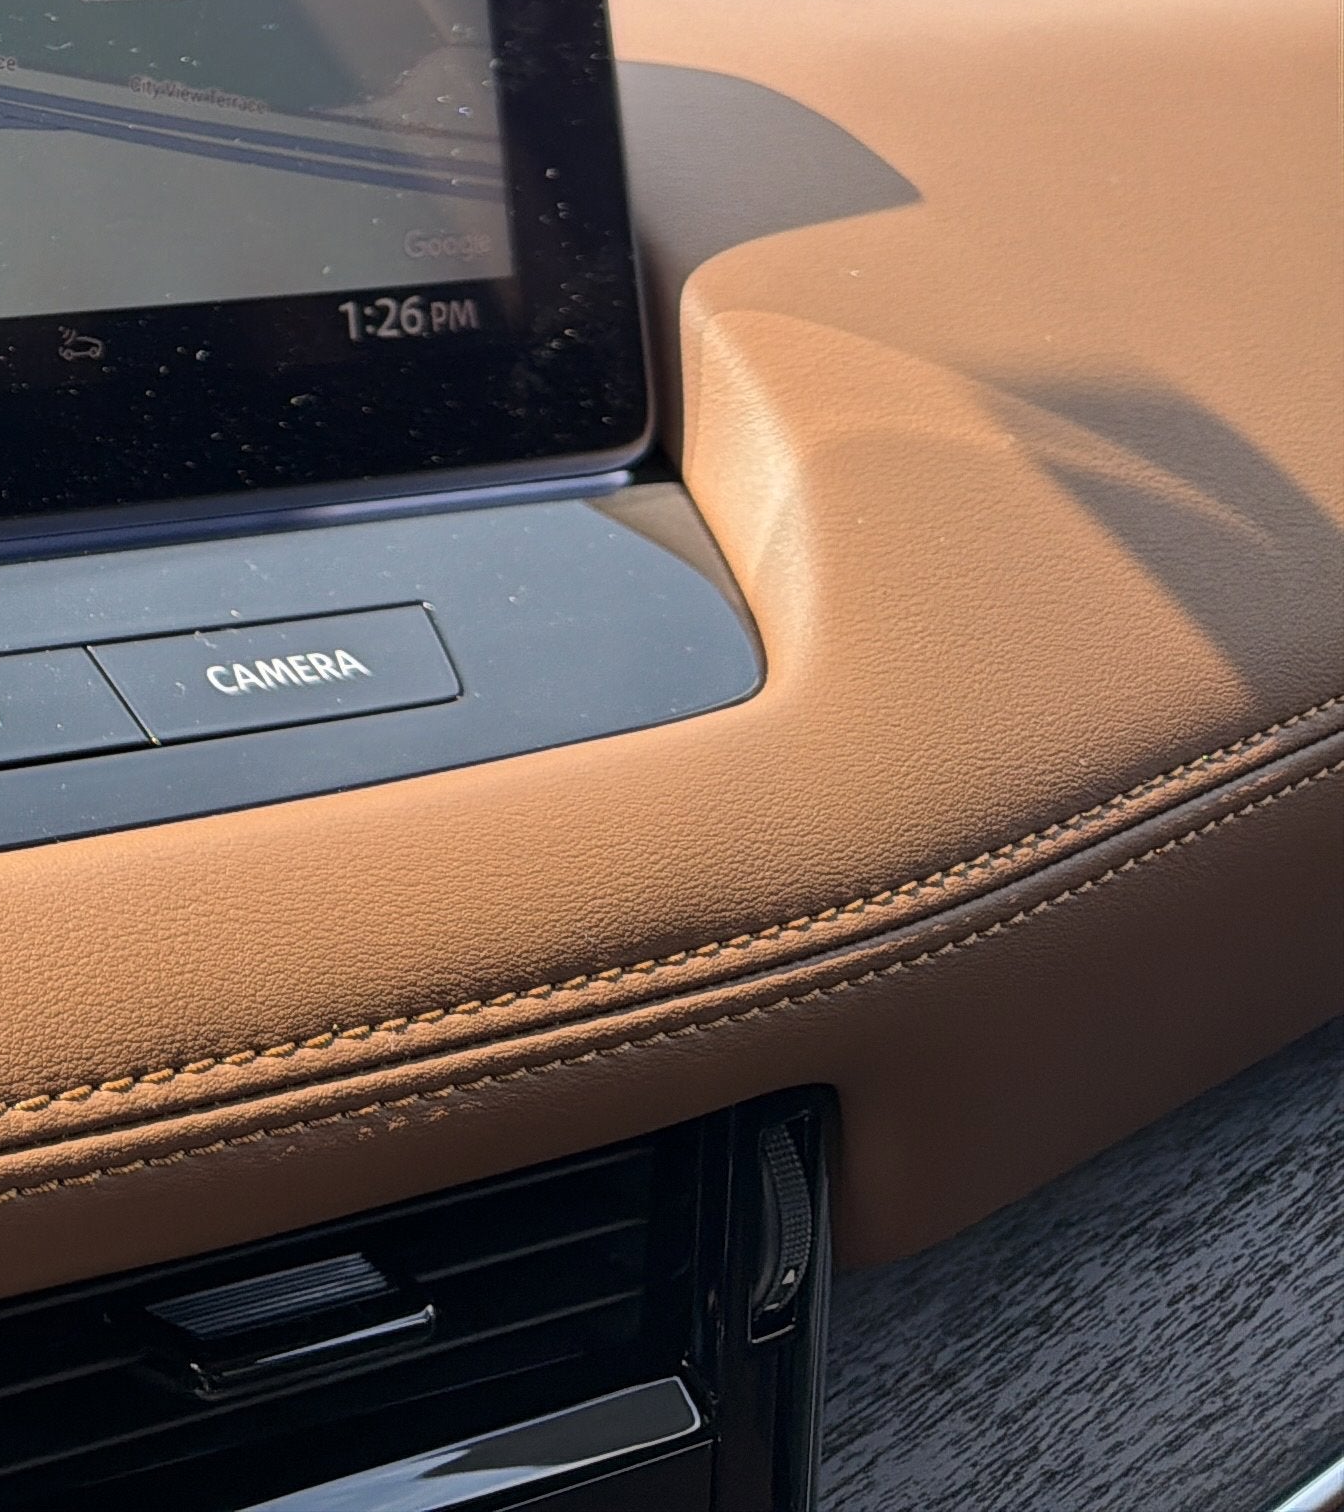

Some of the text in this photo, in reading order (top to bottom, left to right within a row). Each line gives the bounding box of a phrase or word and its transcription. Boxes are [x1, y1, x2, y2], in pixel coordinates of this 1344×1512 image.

[128, 76, 162, 98] City
[165, 81, 209, 103] View
[403, 229, 492, 262] Google
[338, 296, 480, 340] 1:26 PM
[205, 648, 372, 695] CAMERA
